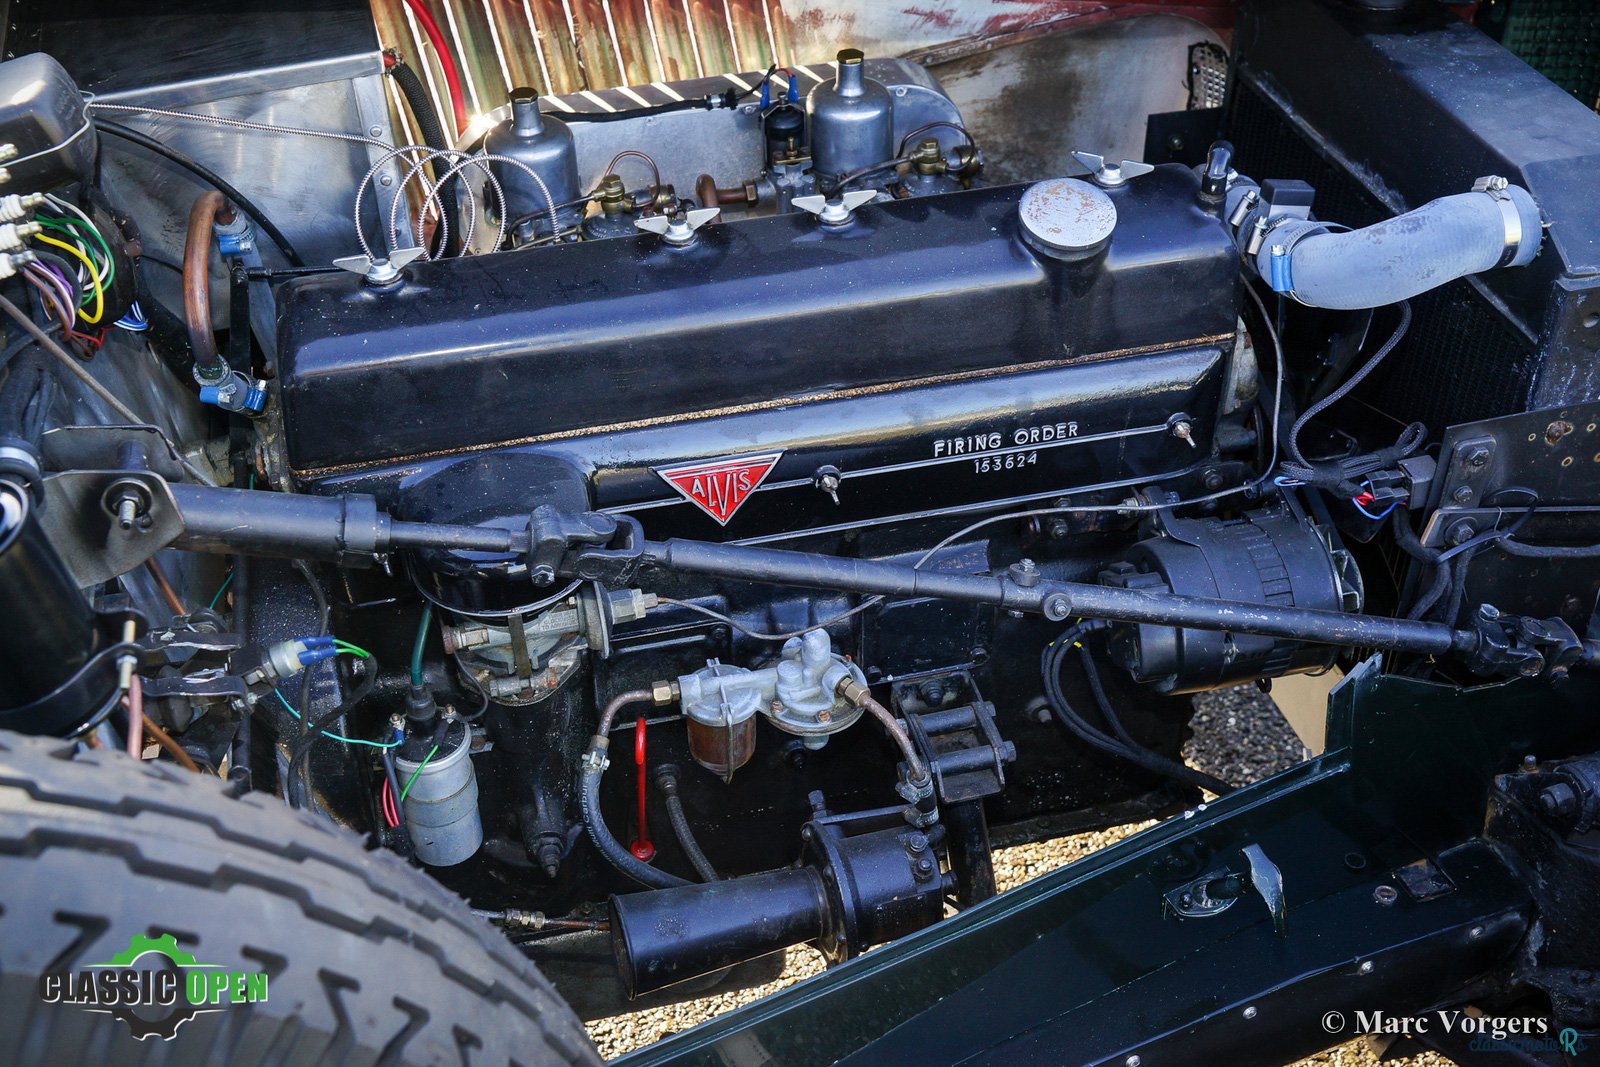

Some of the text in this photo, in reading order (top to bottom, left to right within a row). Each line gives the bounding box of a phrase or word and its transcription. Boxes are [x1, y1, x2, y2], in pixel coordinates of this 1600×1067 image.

[933, 421, 1078, 458] FIRING ORDER
[974, 451, 1038, 474] 153624
[691, 469, 751, 516] ALVIS
